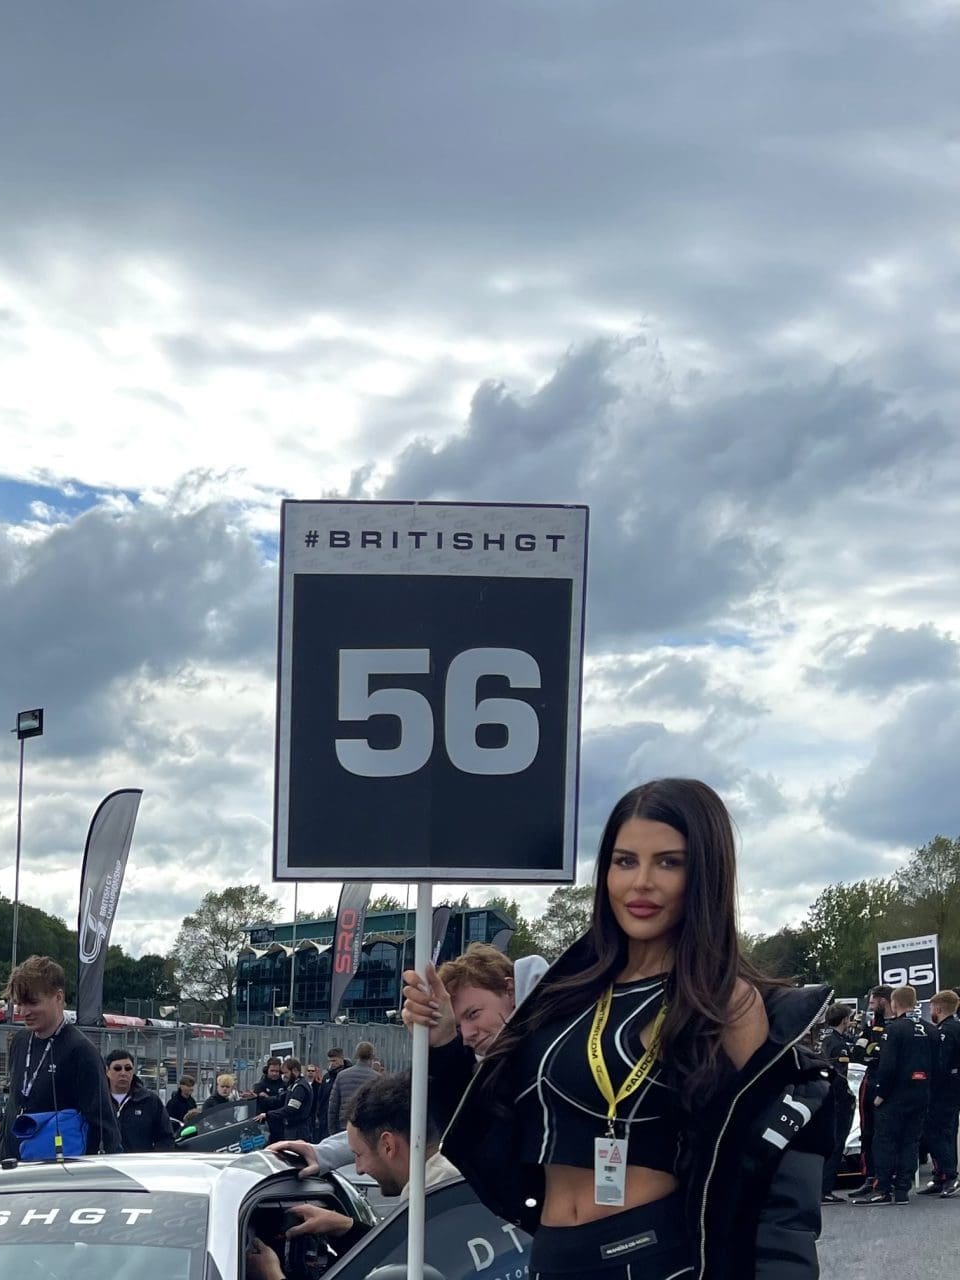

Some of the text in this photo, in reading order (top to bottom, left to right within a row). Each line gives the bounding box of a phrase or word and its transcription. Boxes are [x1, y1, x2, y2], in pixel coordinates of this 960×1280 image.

[304, 529, 567, 553] #BRITISHGT
[334, 647, 542, 778] 56
[99, 885, 111, 917] BRITISH
[335, 908, 356, 974] SRO
[883, 963, 935, 987] 95
[780, 1114, 800, 1132] DTO
[466, 1222, 524, 1273] DT
